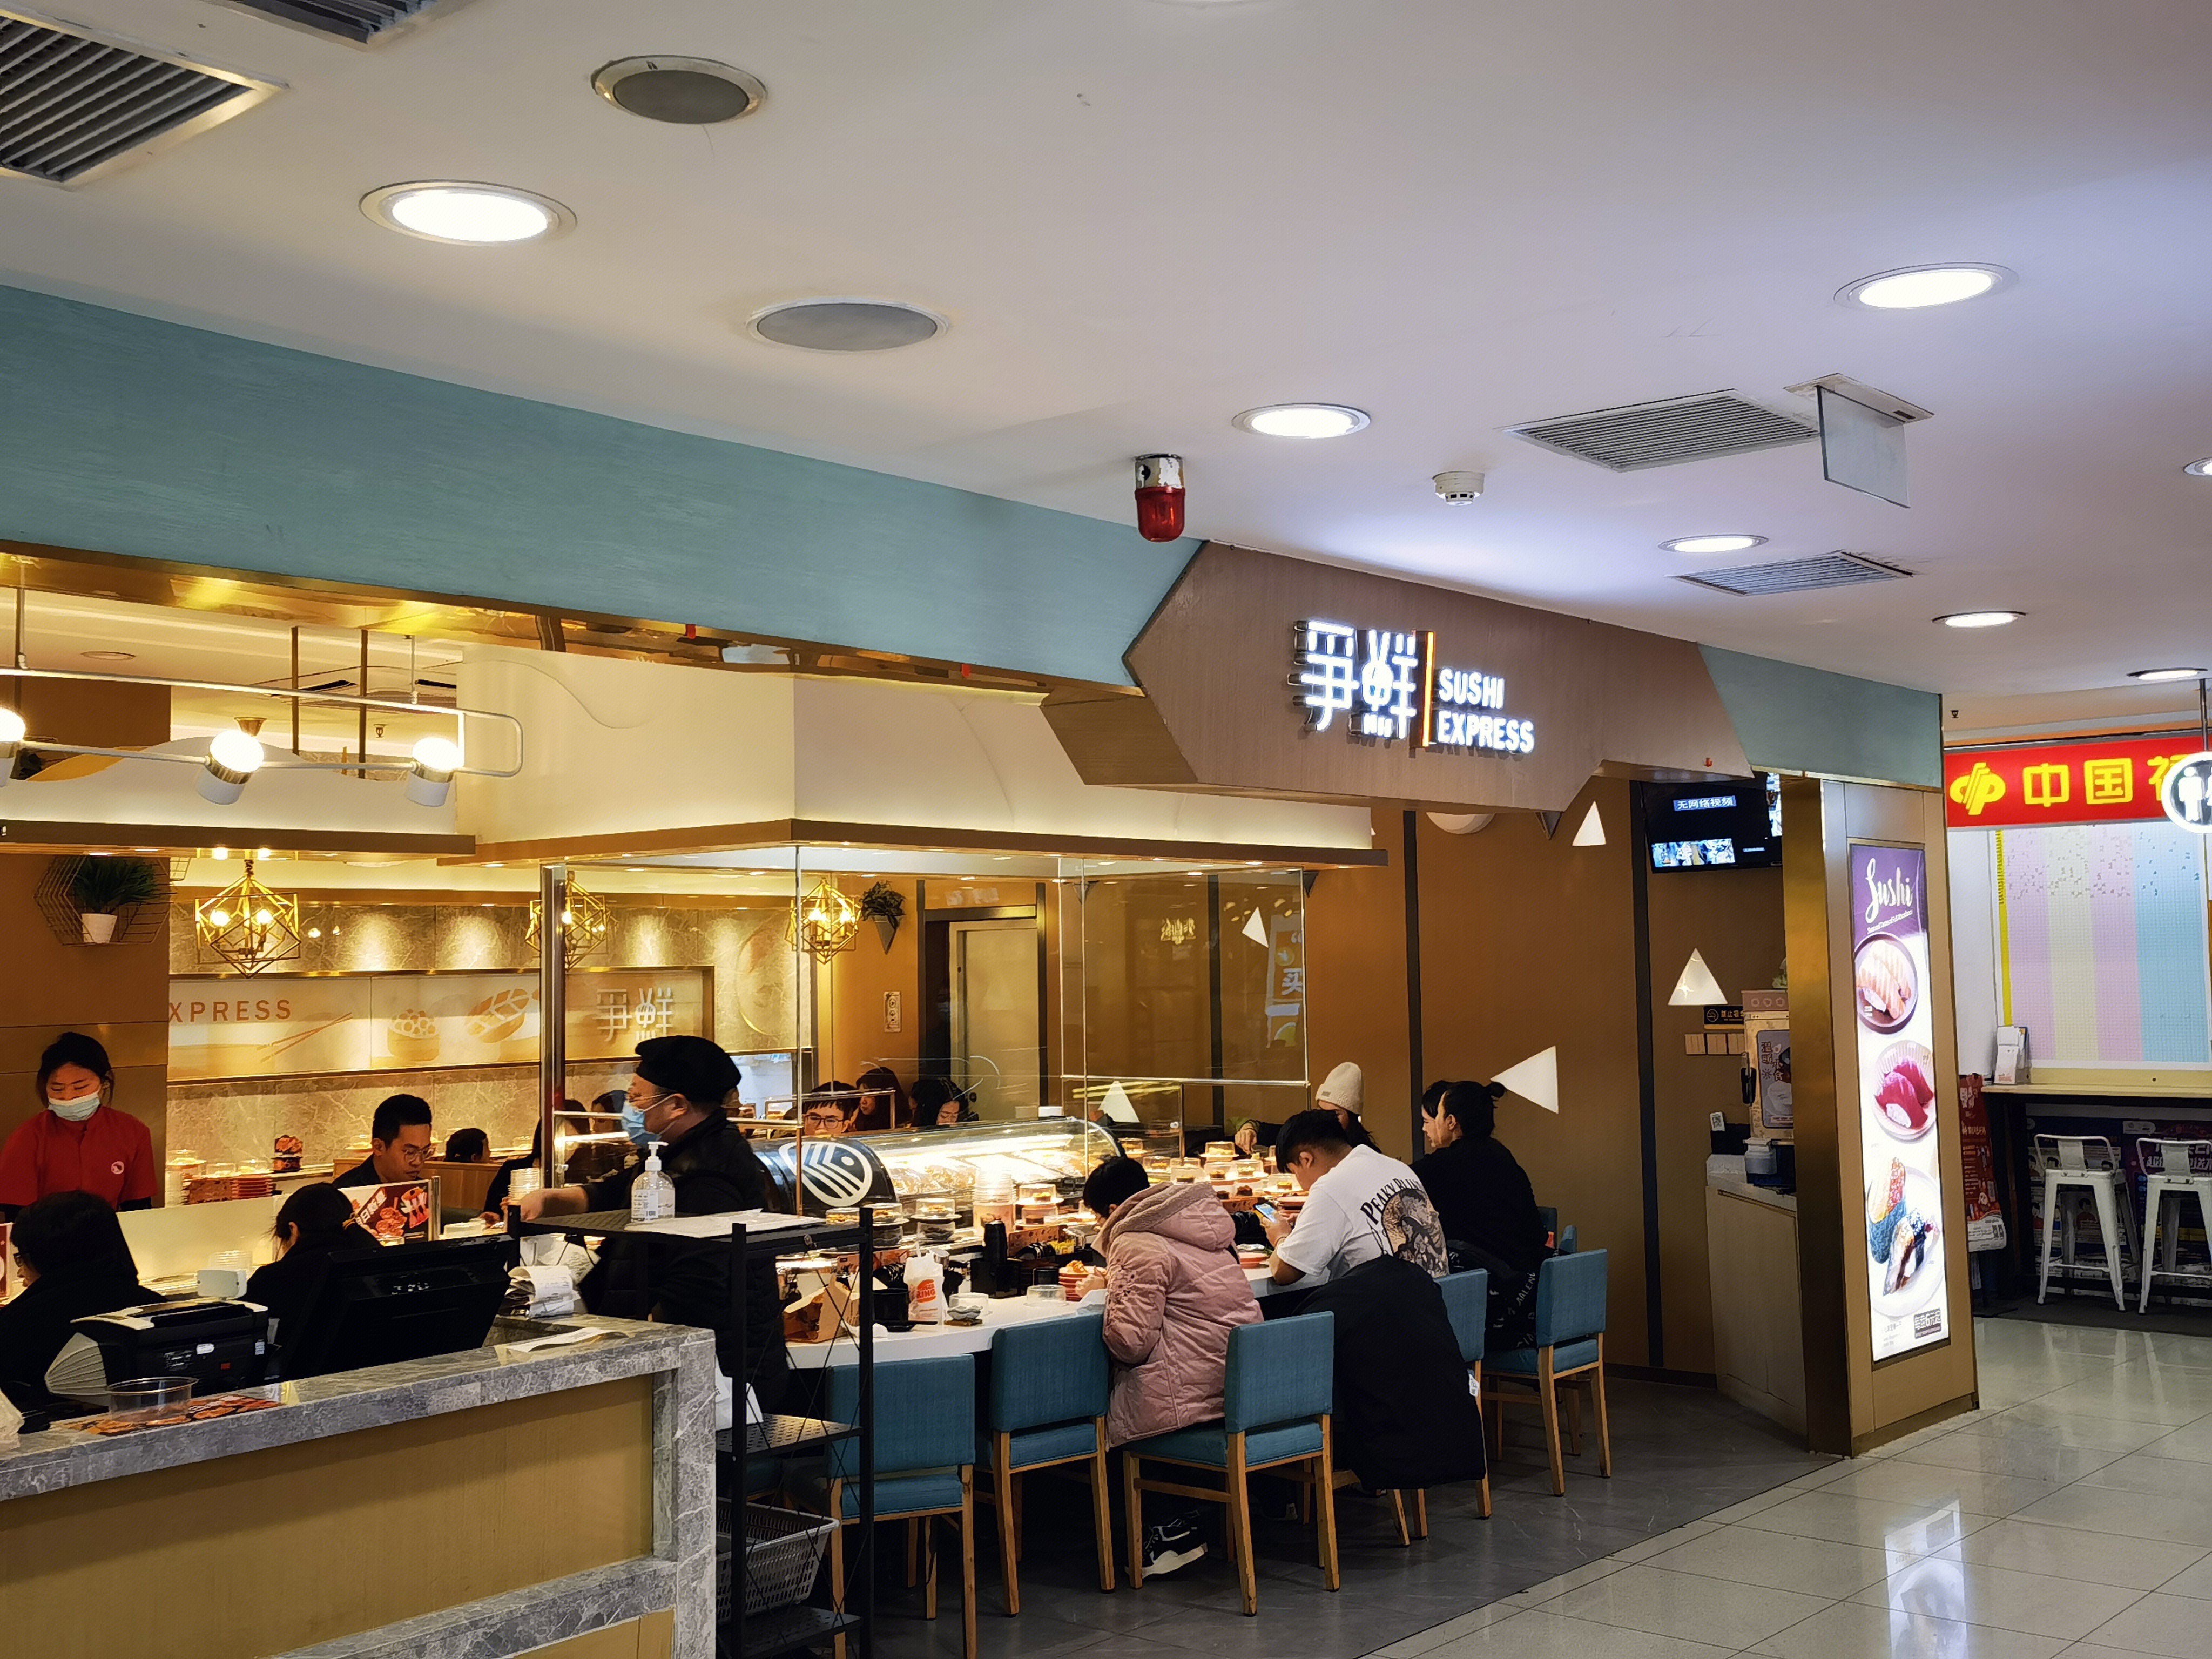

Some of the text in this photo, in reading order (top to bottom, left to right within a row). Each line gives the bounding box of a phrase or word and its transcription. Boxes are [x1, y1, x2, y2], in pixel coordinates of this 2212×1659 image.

[1438, 667, 1506, 710] SUSHI
[1437, 710, 1534, 754] EXPRESS
[1677, 797, 1734, 810] 无网络视频
[1865, 858, 1913, 923] Sushi
[1360, 1183, 1396, 1225] PEAKY
